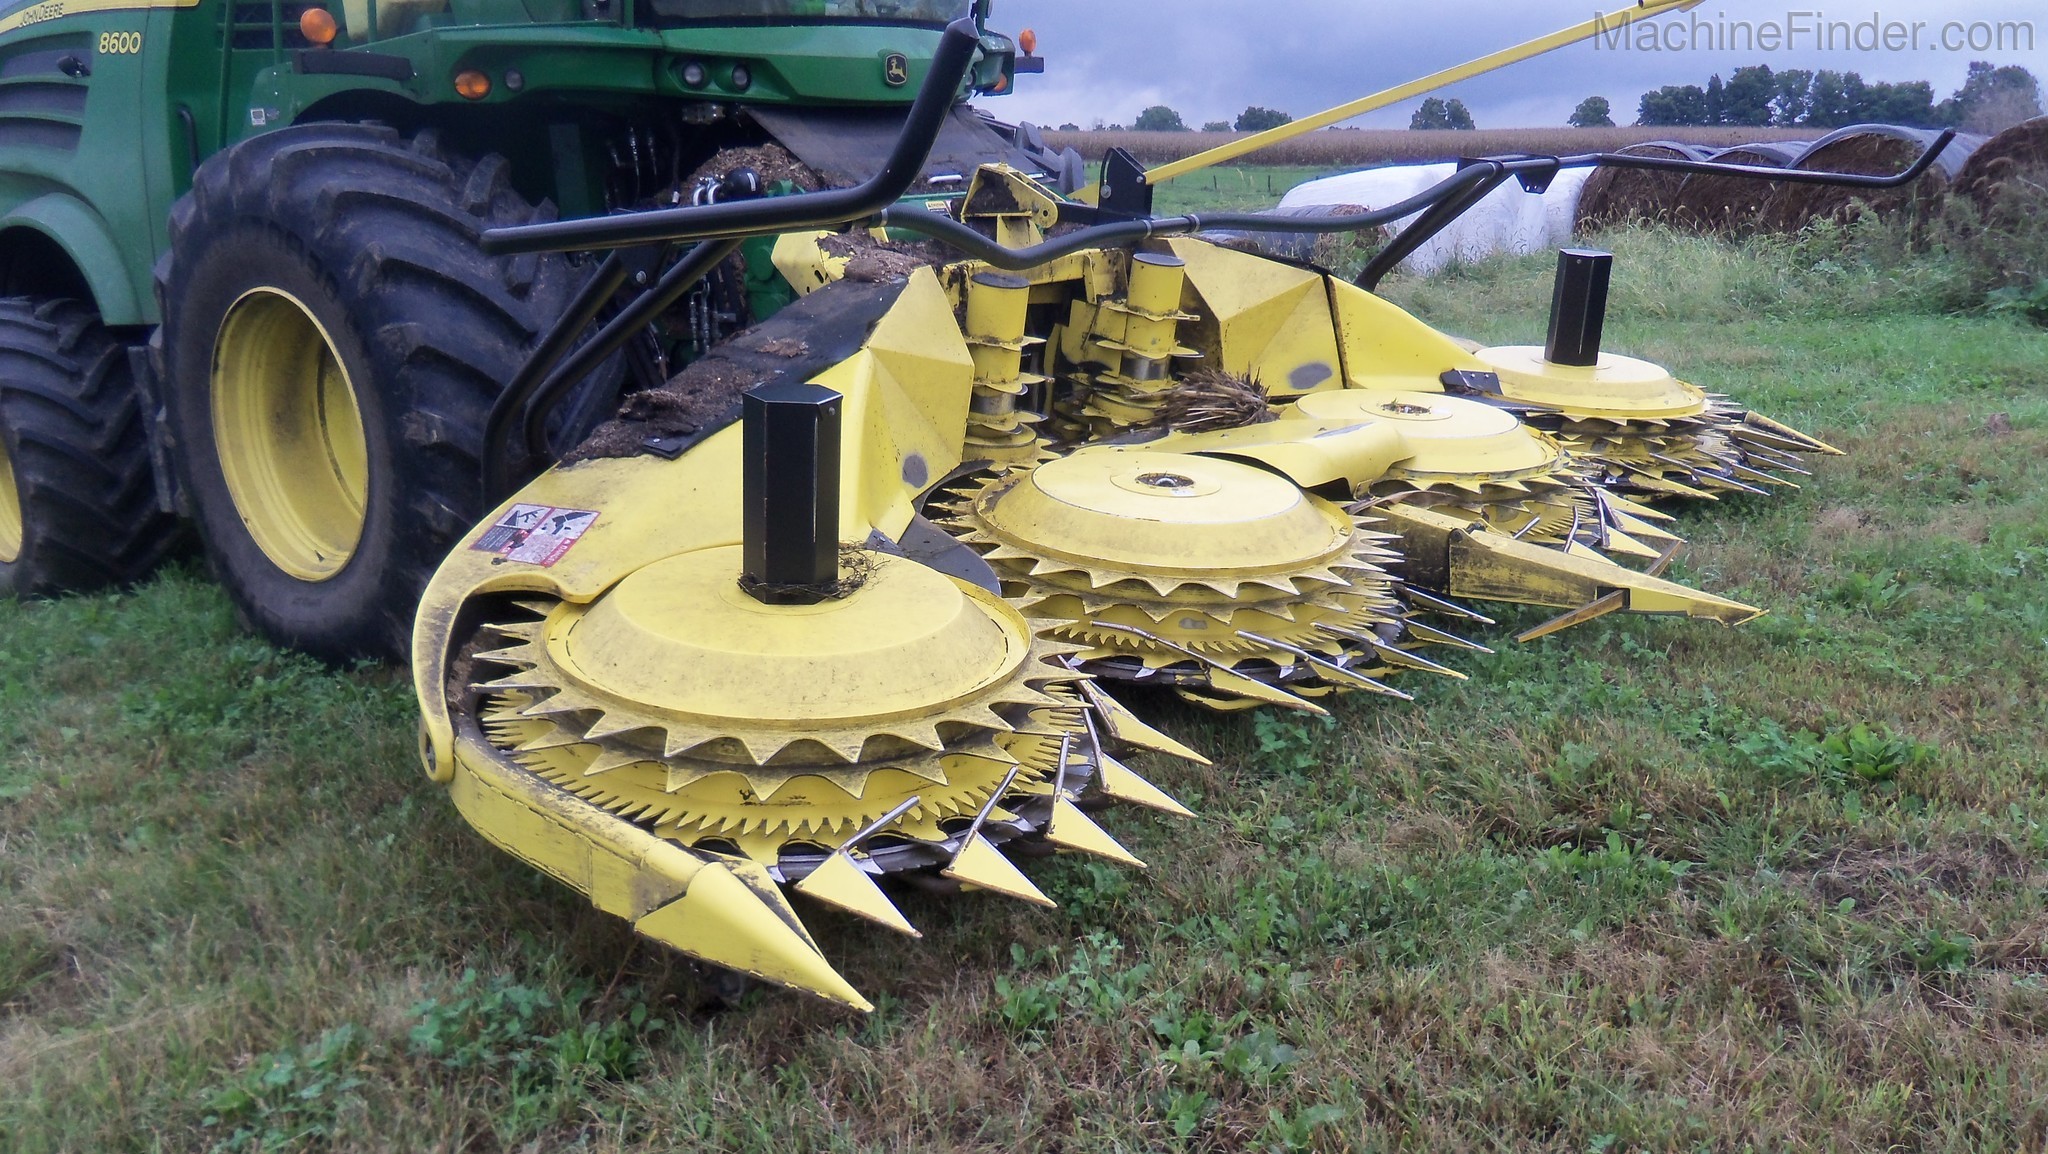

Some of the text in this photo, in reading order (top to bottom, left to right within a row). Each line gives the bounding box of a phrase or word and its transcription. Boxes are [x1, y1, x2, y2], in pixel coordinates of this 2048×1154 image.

[19, 2, 64, 26] JOHN DEERE
[99, 31, 141, 54] 8600
